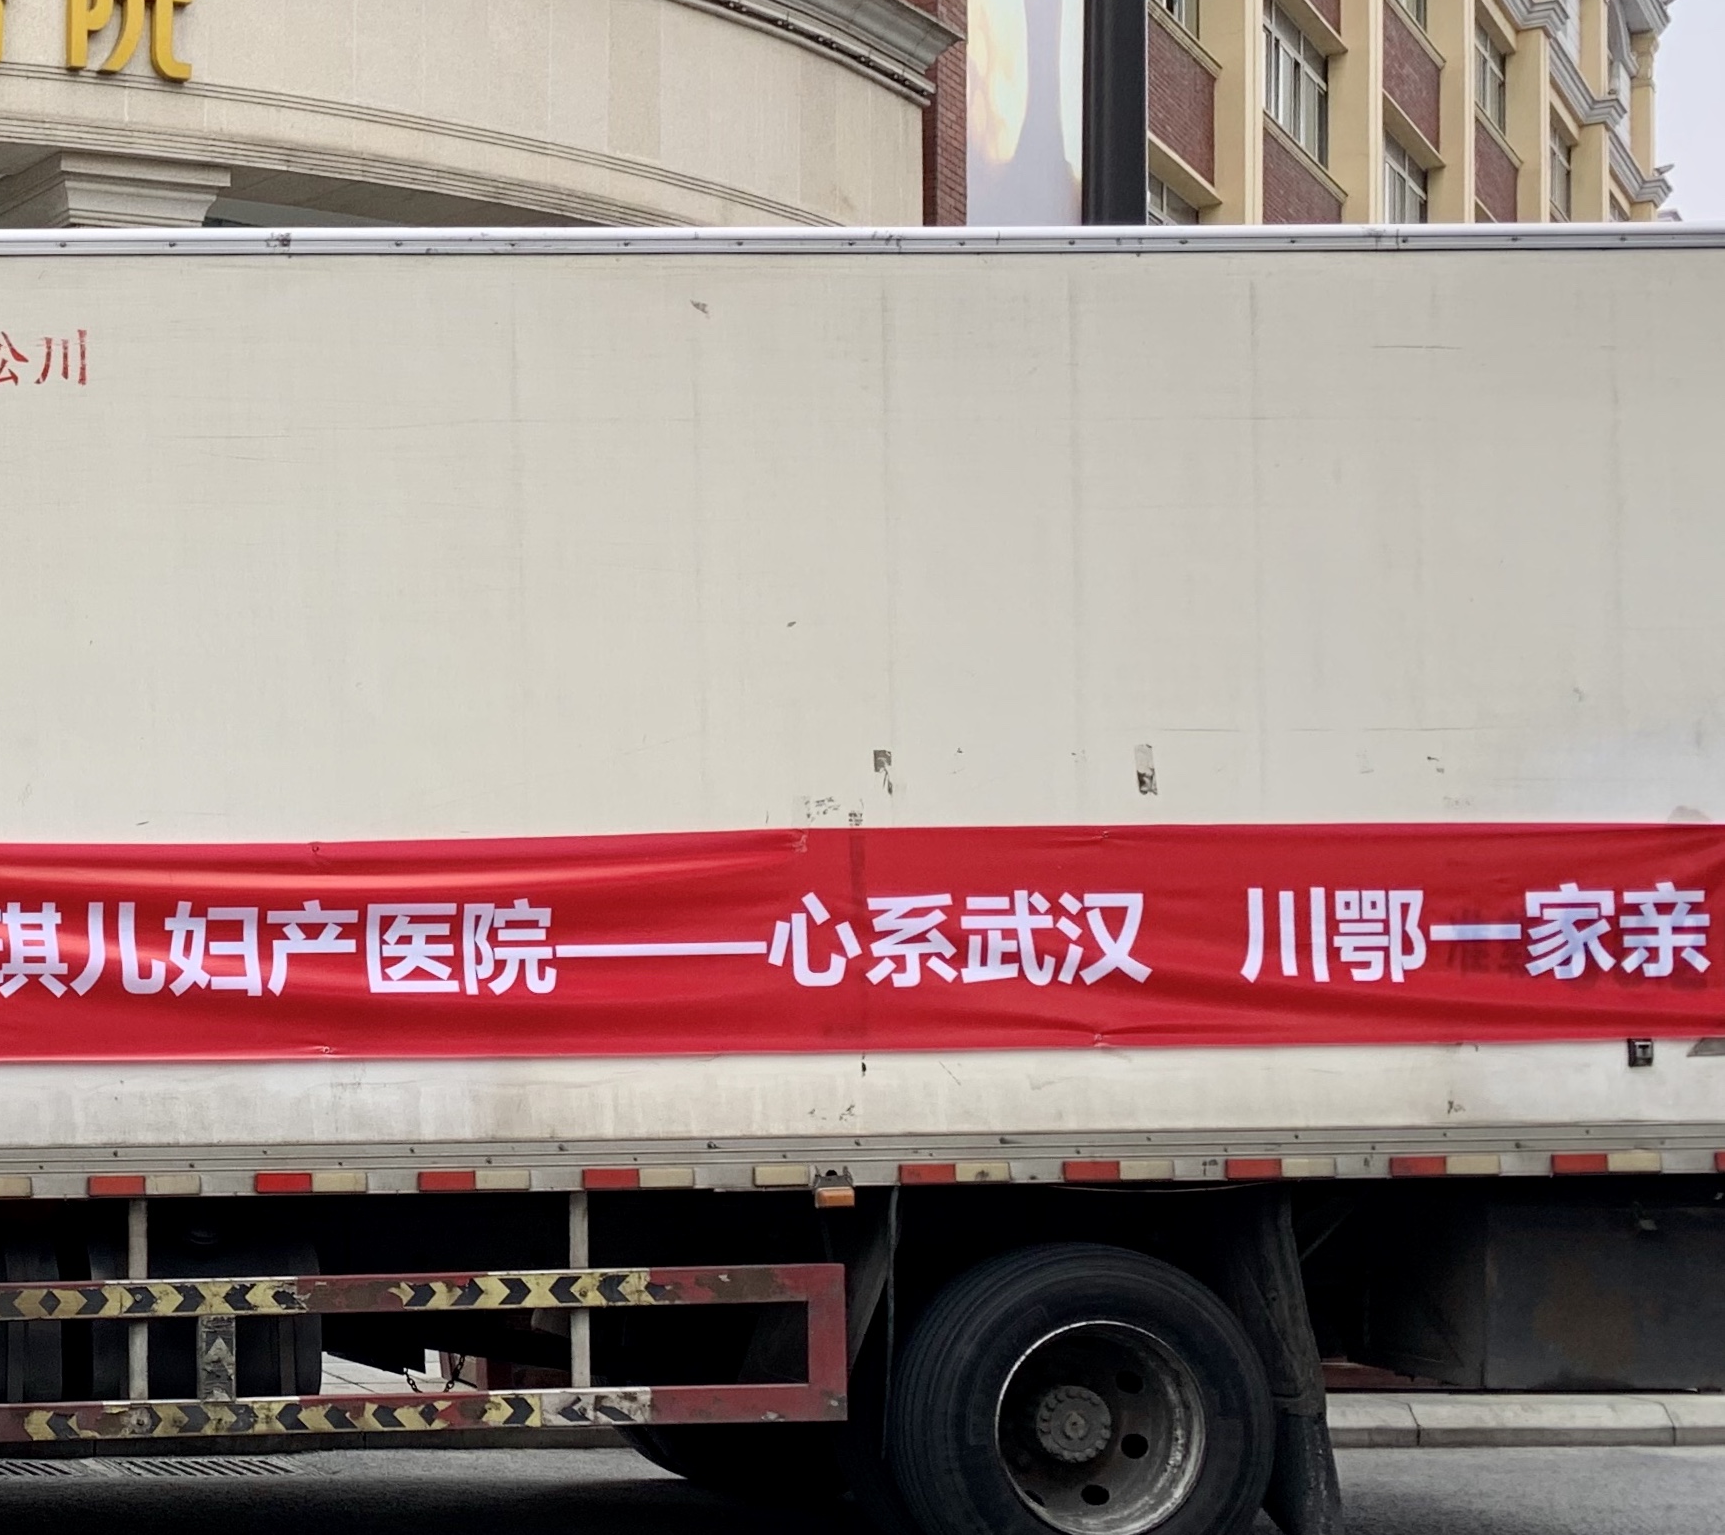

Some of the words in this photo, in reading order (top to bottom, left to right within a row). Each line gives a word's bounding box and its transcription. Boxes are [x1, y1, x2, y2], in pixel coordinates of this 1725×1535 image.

[1239, 881, 1711, 984] 川鄂一家亲
